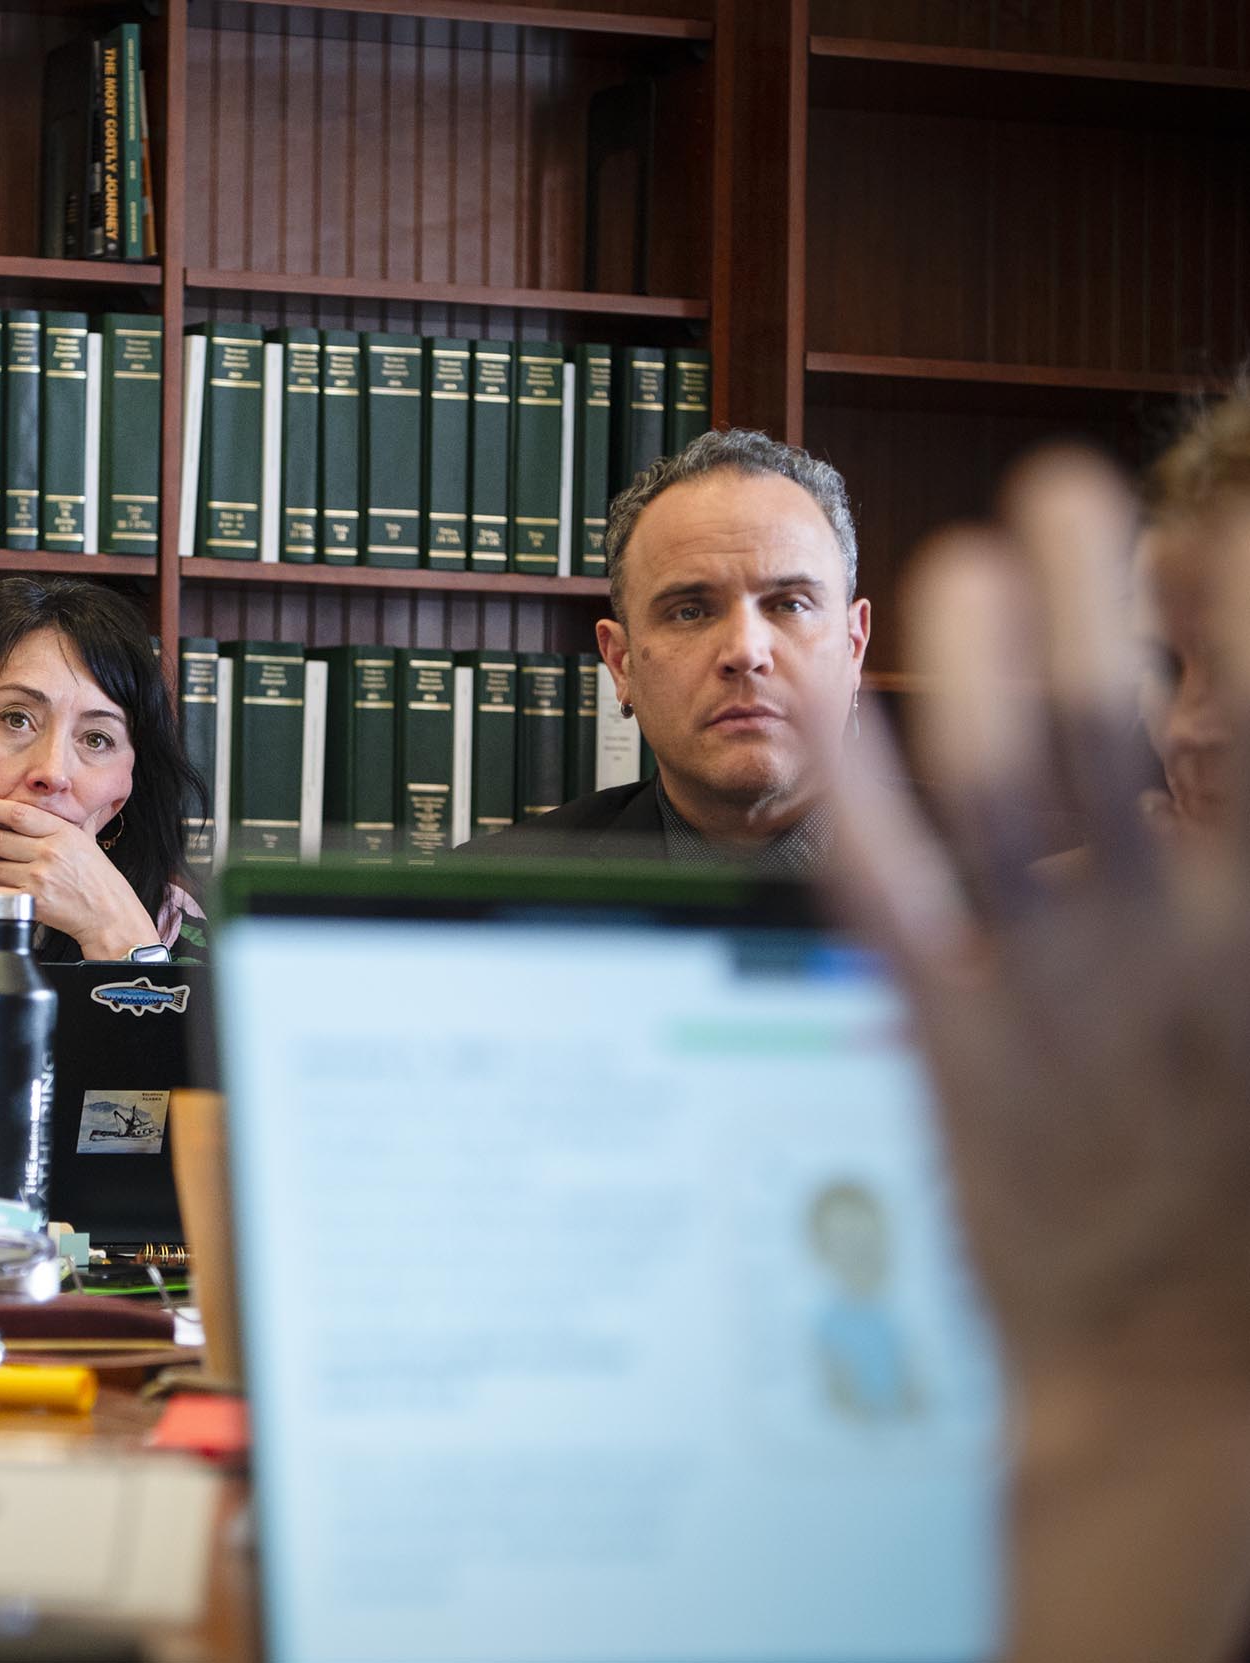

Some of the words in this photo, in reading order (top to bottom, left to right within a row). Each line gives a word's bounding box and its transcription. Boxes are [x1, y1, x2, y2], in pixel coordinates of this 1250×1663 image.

[104, 47, 117, 75] THE
[104, 77, 117, 116] MOST
[105, 118, 118, 173] COSTLY
[106, 174, 119, 241] JOURNEY
